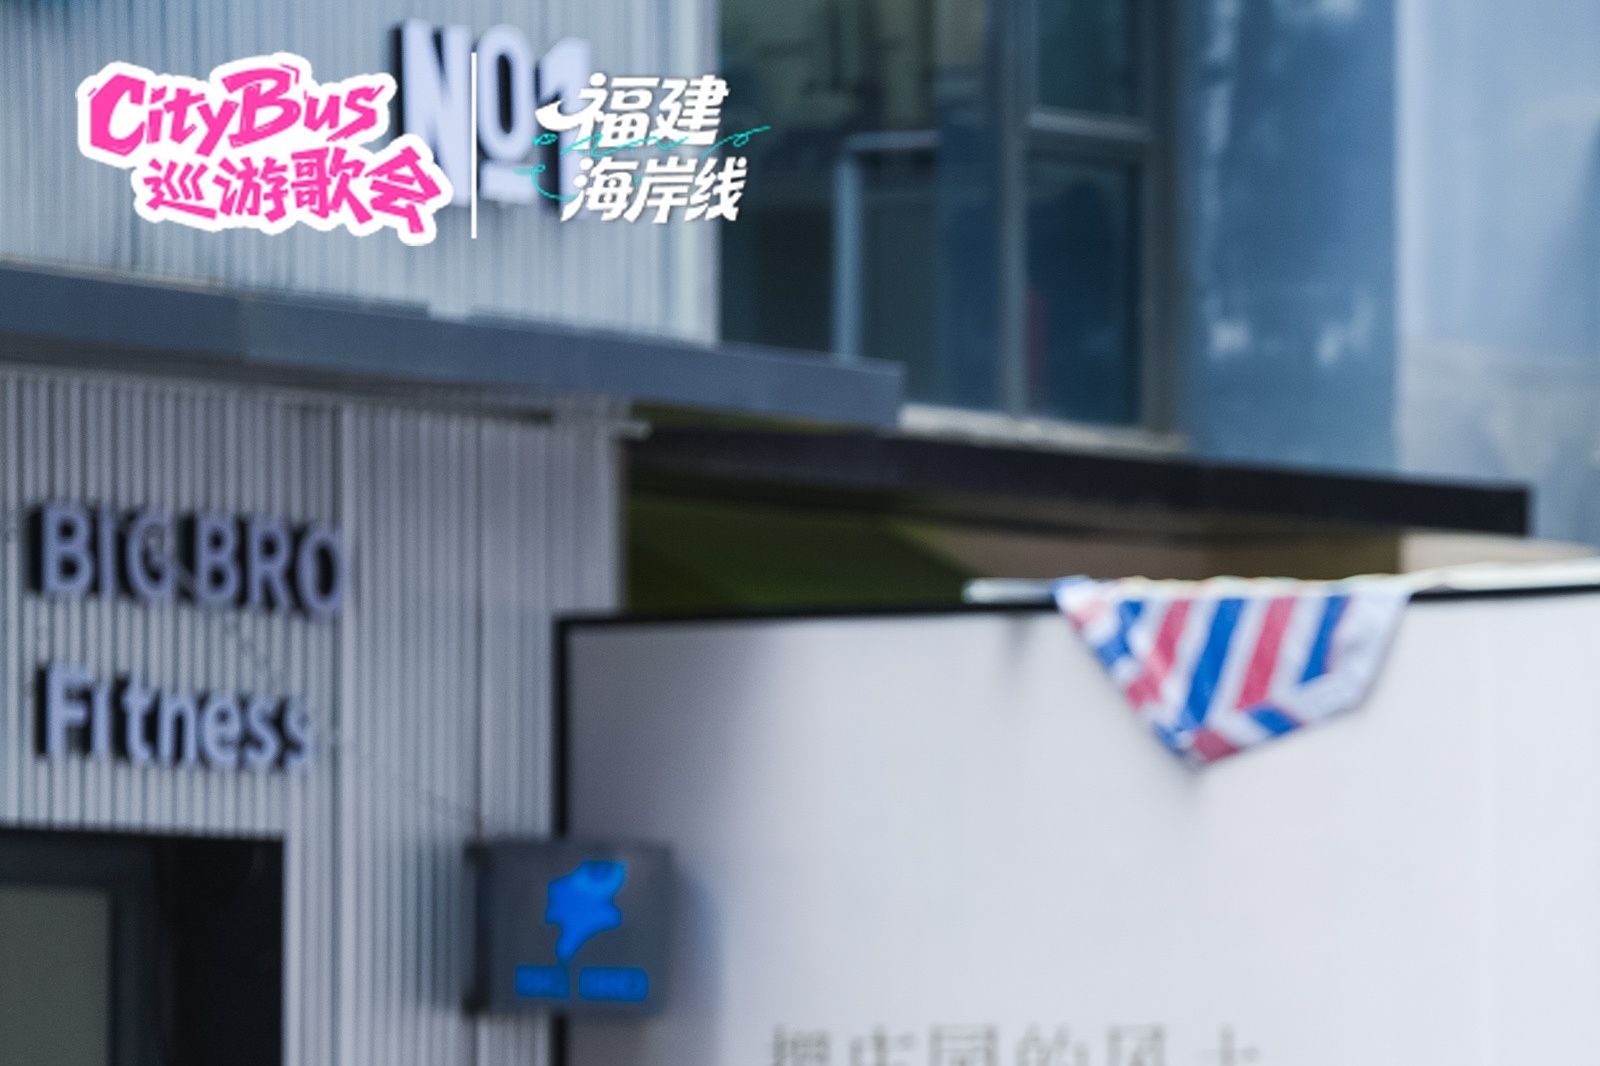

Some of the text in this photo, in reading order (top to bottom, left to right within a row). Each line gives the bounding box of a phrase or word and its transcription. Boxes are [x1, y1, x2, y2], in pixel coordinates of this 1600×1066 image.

[40, 502, 344, 617] BIG BRO
[44, 664, 314, 773] Fitness
